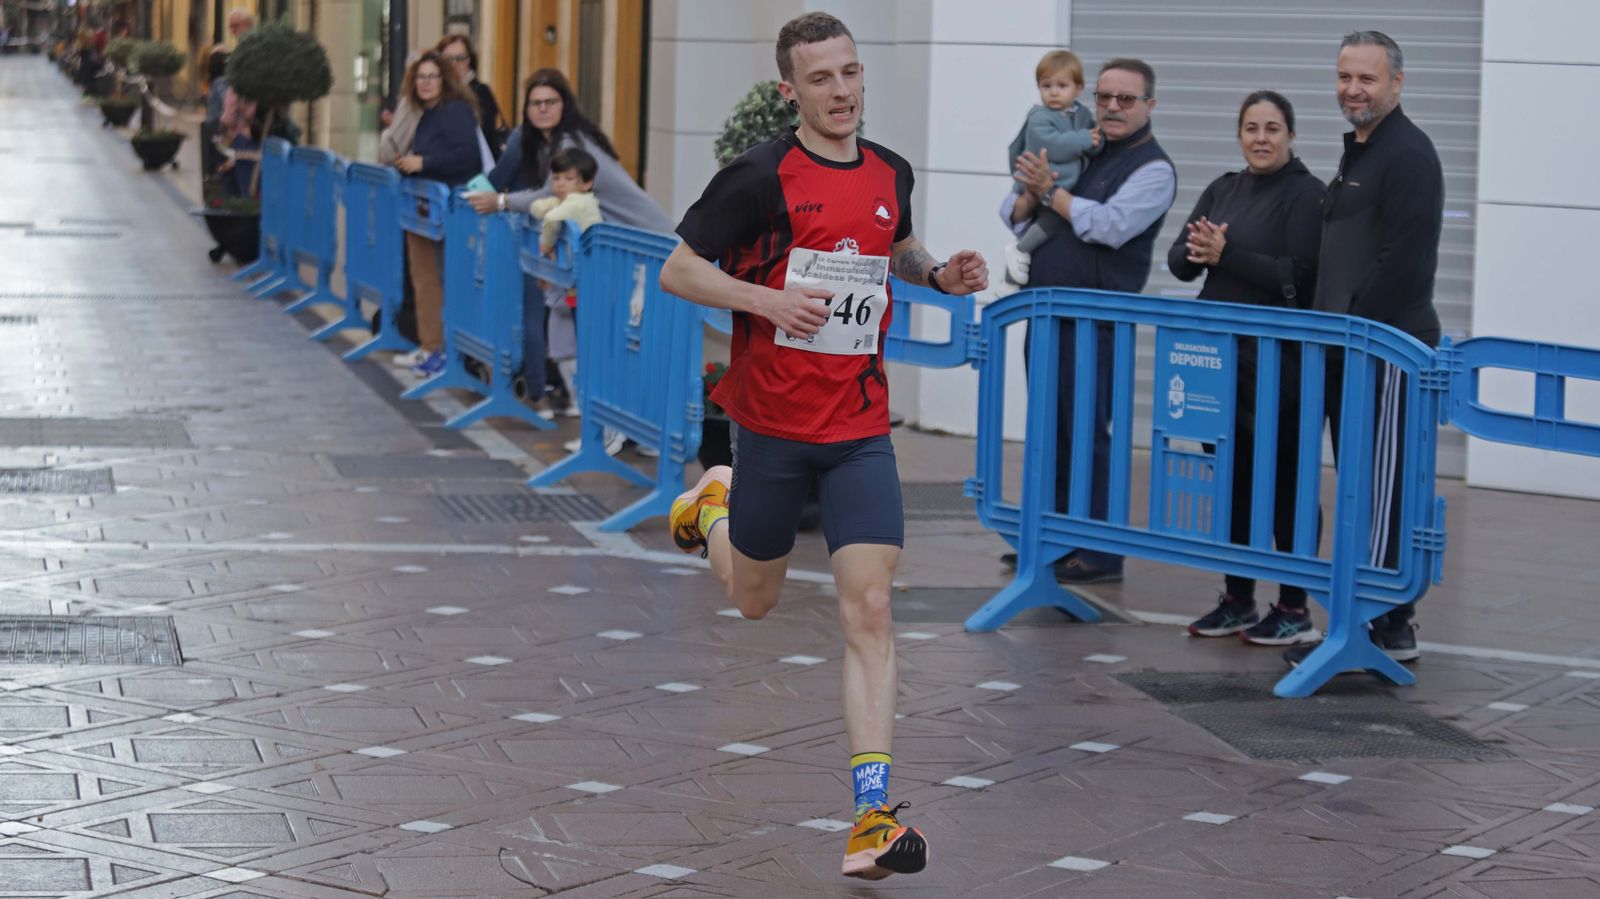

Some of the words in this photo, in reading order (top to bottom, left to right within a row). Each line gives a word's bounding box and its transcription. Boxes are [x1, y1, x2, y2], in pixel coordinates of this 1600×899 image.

[795, 200, 823, 213] vive
[1170, 352, 1222, 370] DEPORTES
[856, 763, 886, 781] MAKE
[861, 774, 882, 790] LOVE
